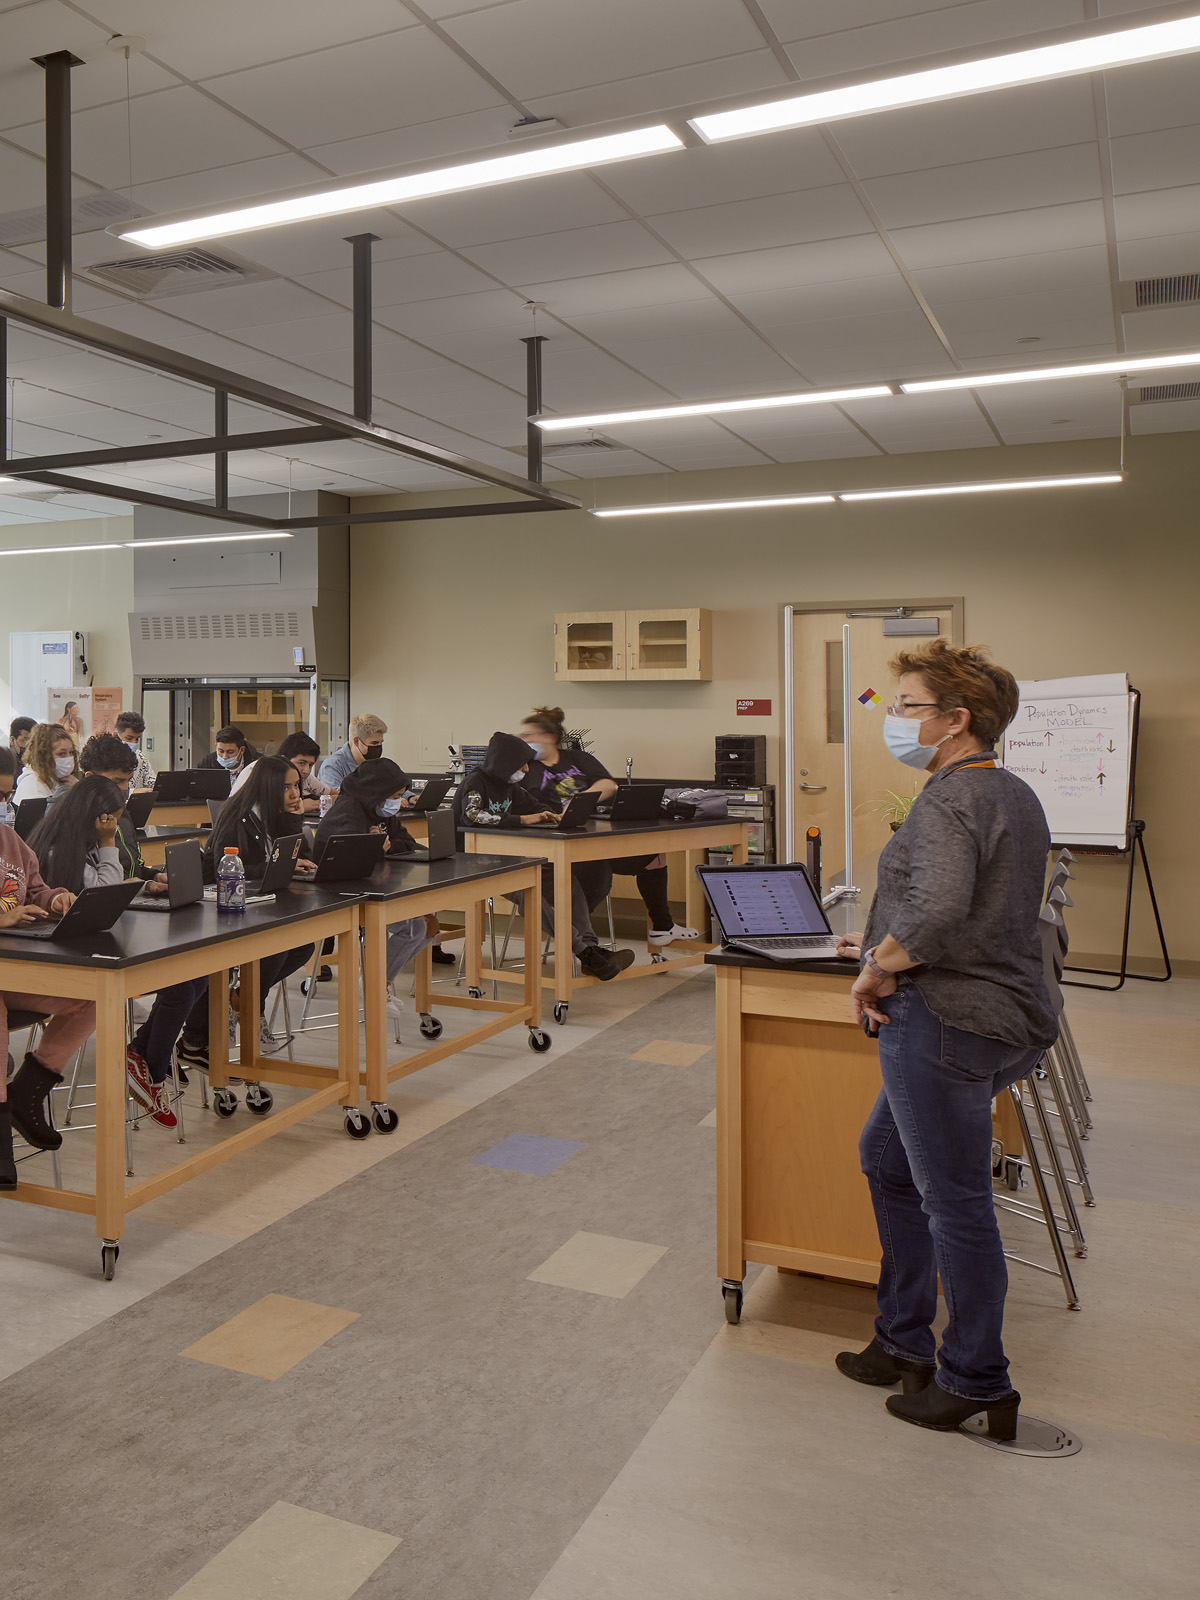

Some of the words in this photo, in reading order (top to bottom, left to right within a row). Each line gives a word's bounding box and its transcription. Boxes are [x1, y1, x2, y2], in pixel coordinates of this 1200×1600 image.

[1024, 705, 1067, 721] Population
[1067, 703, 1107, 718] Dynamics
[1046, 717, 1093, 727] MODEL
[1009, 739, 1044, 751] population
[236, 884, 243, 895] G
